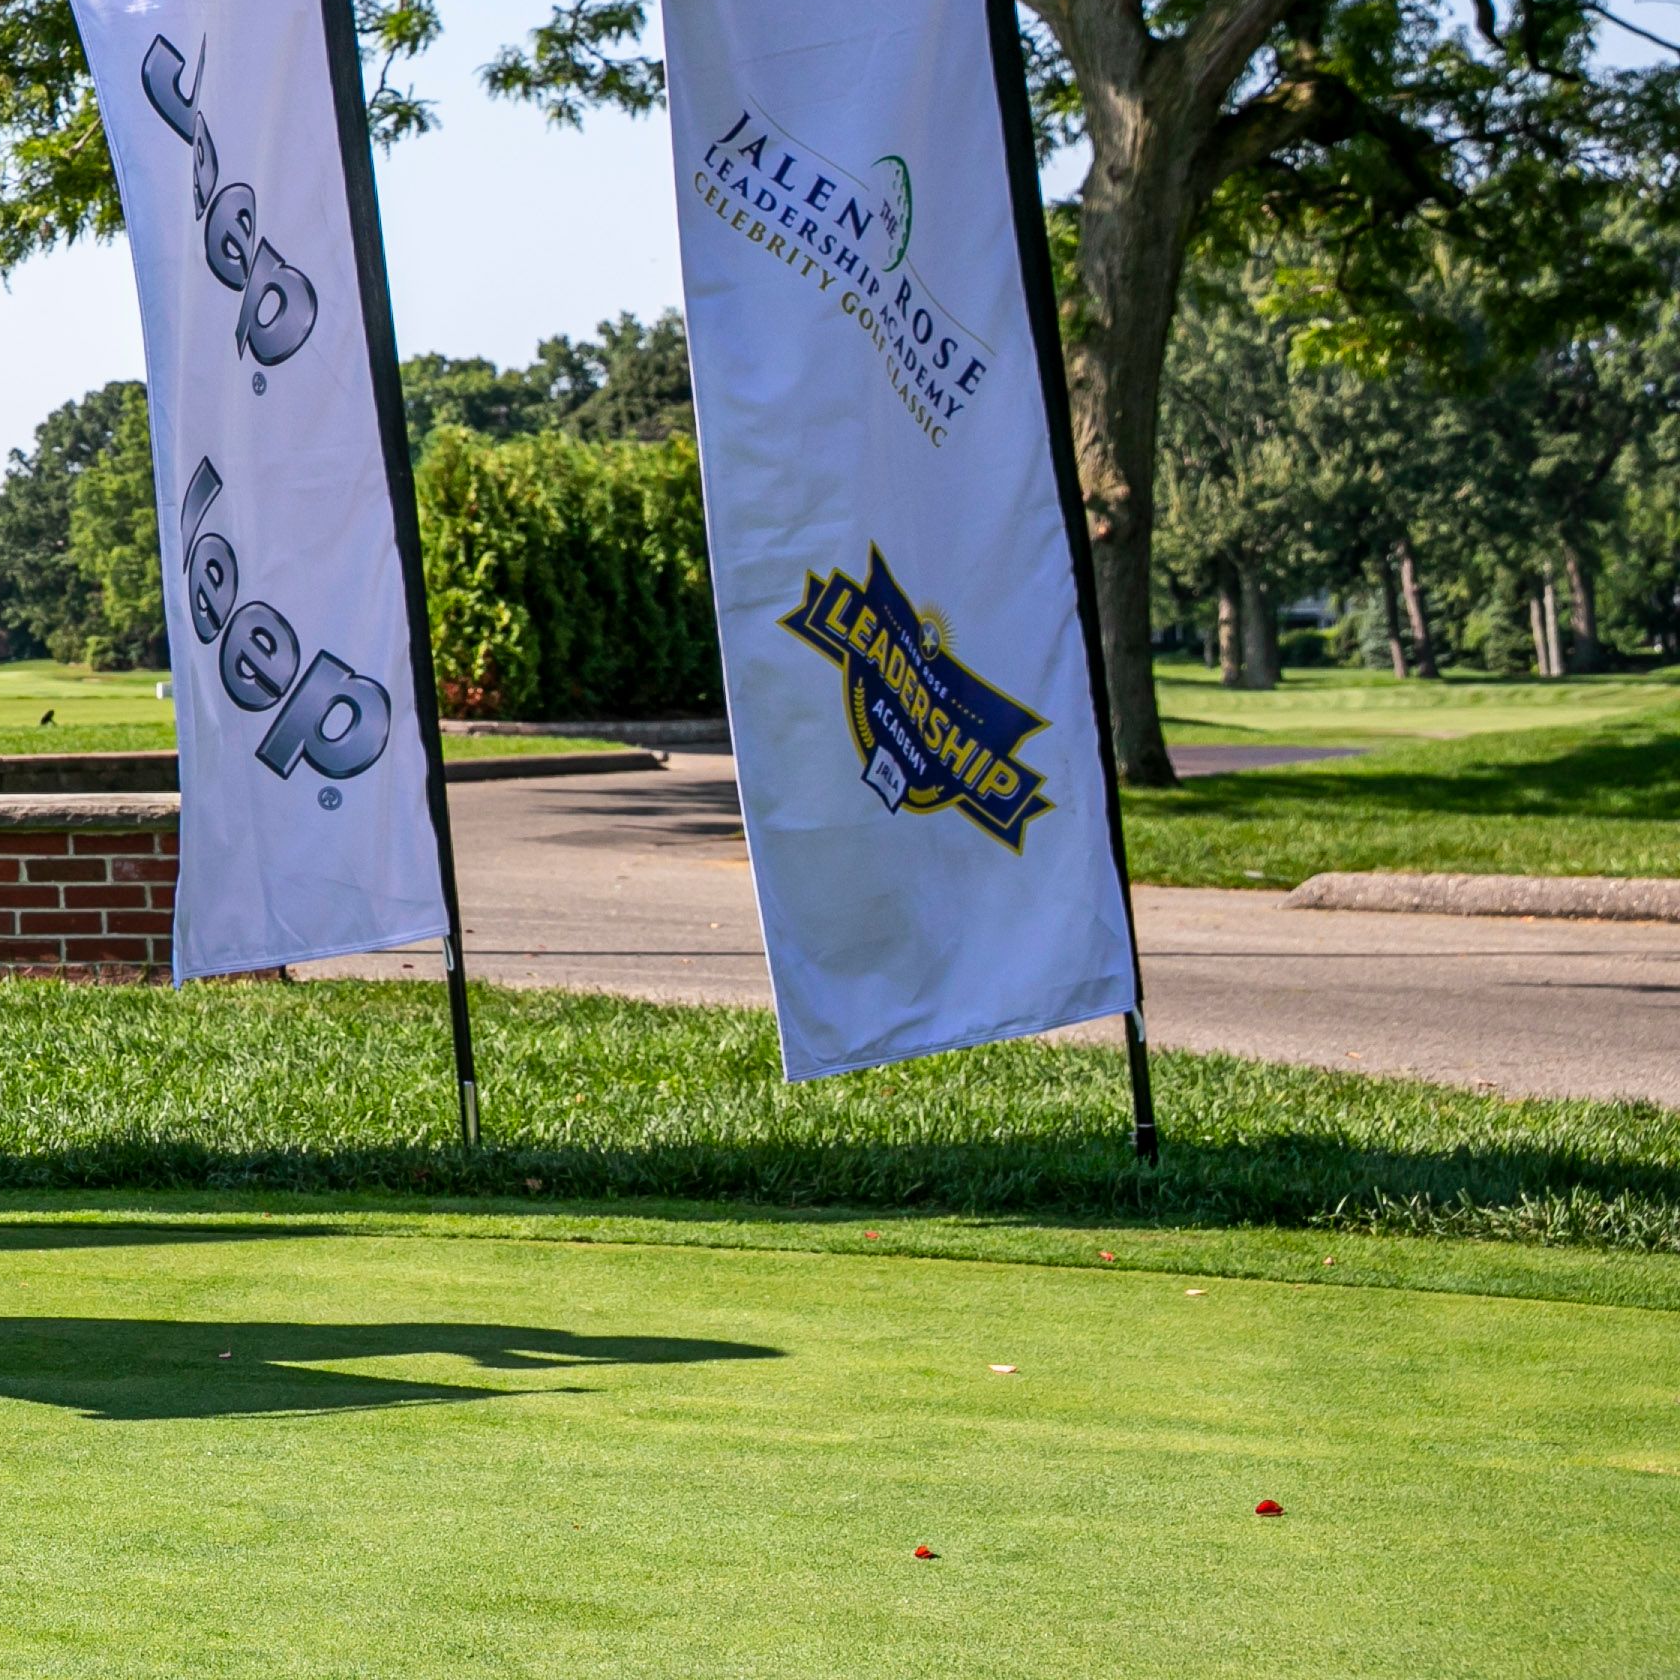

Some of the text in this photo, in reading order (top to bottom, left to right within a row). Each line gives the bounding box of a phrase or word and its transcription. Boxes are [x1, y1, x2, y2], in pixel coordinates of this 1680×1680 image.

[693, 169, 949, 451] CELEBRITY GOLF CLASSIC
[702, 141, 964, 423] LEADERSHIP ACADEMY
[717, 110, 988, 396] JALEN THE ROSE
[826, 587, 1022, 803] LEADERSHIP
[871, 698, 929, 777] ACADEMY
[899, 626, 950, 701] JALEN ROSE
[875, 757, 901, 794] JRLA
